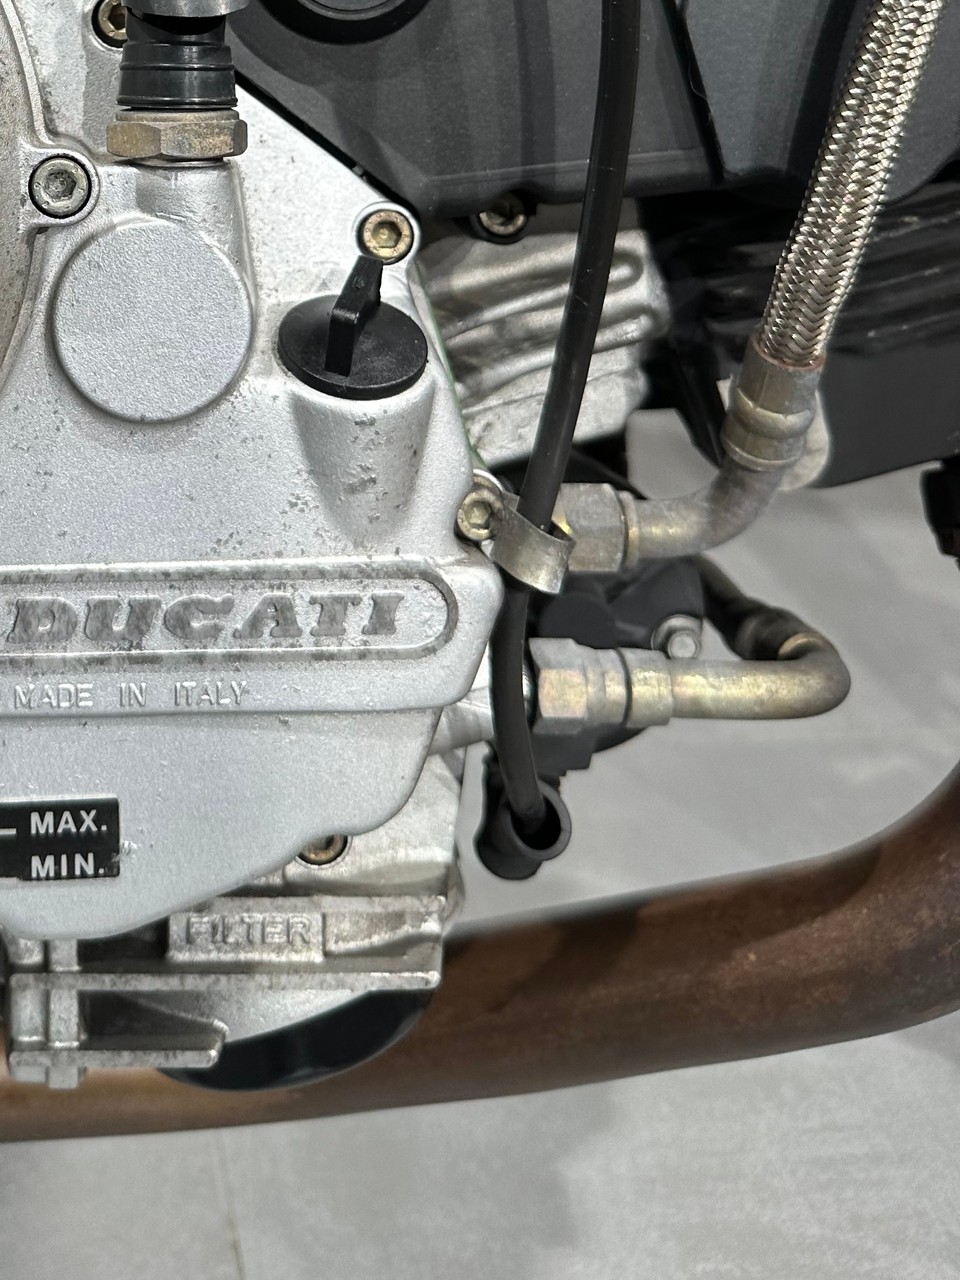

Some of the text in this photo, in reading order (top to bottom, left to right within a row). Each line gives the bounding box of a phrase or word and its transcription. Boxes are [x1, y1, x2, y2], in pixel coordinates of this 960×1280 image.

[5, 592, 405, 645] DUCATI
[13, 680, 248, 710] MADE IN ITALY
[30, 809, 108, 834] MAX.
[31, 852, 105, 878] MIN.
[185, 912, 312, 945] FILTER
